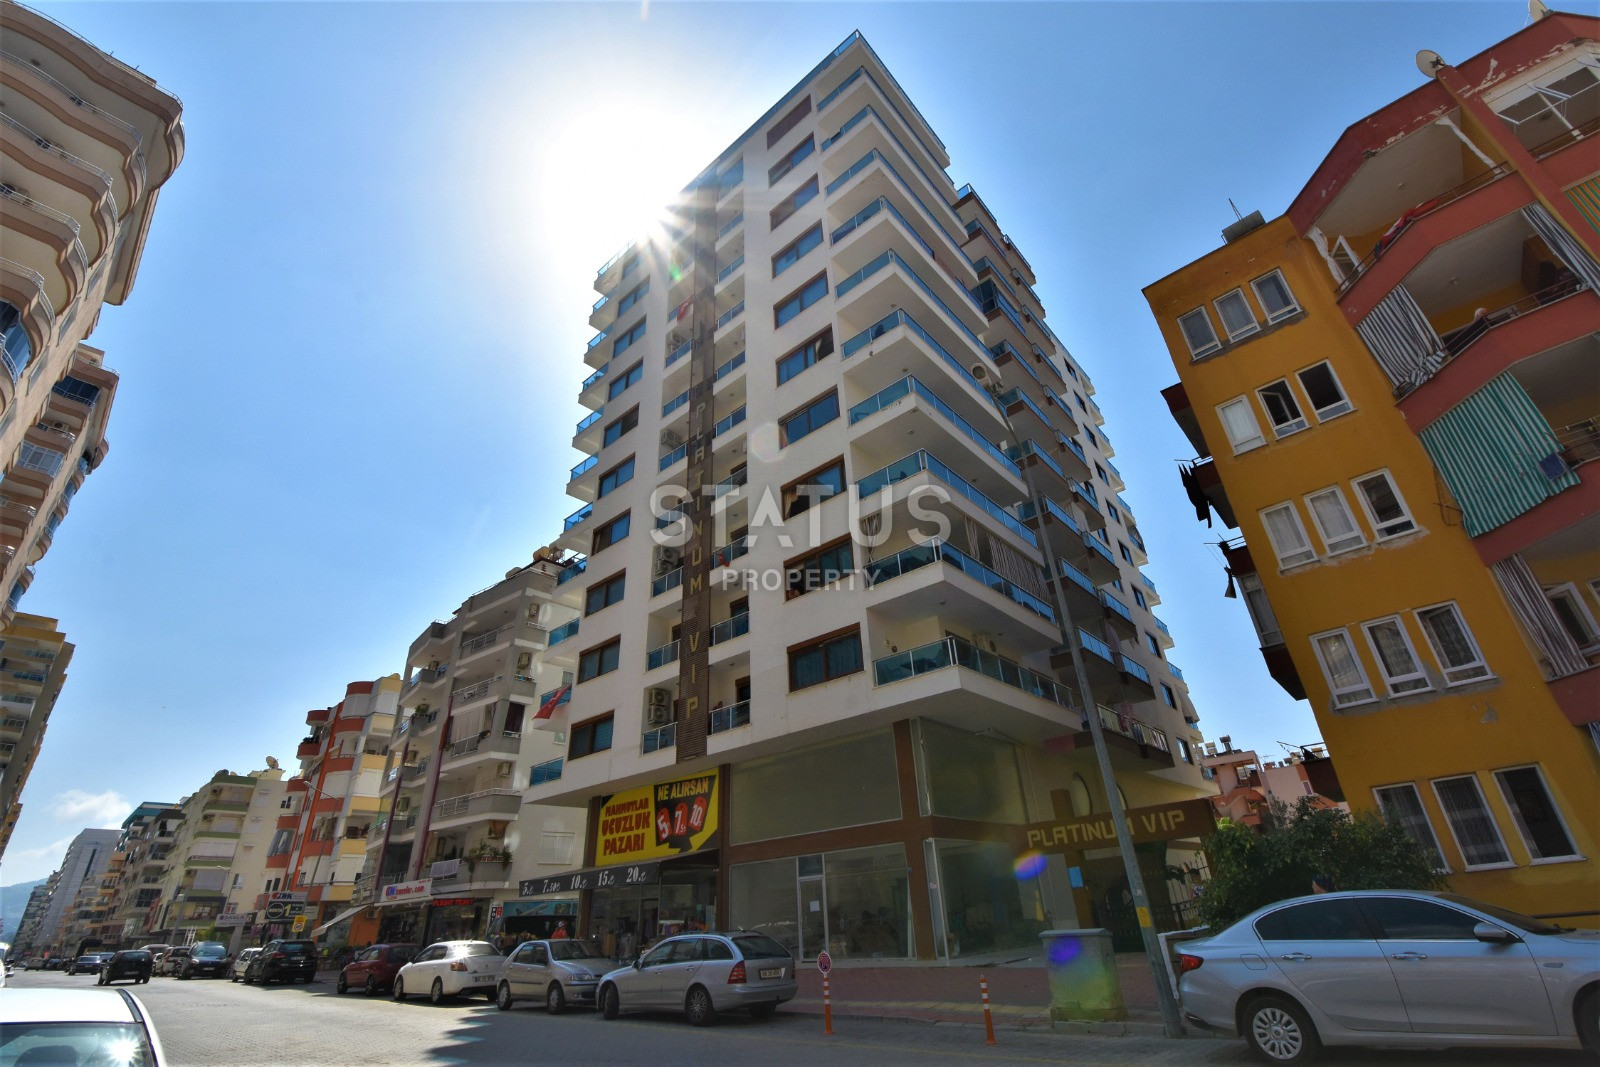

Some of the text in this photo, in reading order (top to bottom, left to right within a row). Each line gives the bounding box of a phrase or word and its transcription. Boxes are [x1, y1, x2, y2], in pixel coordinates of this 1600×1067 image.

[686, 401, 706, 720] PLATINUM VIP
[657, 778, 709, 801] NE ALIRSAN
[602, 812, 651, 836] UCUZLUK
[1141, 809, 1185, 834] VIP
[603, 833, 645, 856] PAZARI
